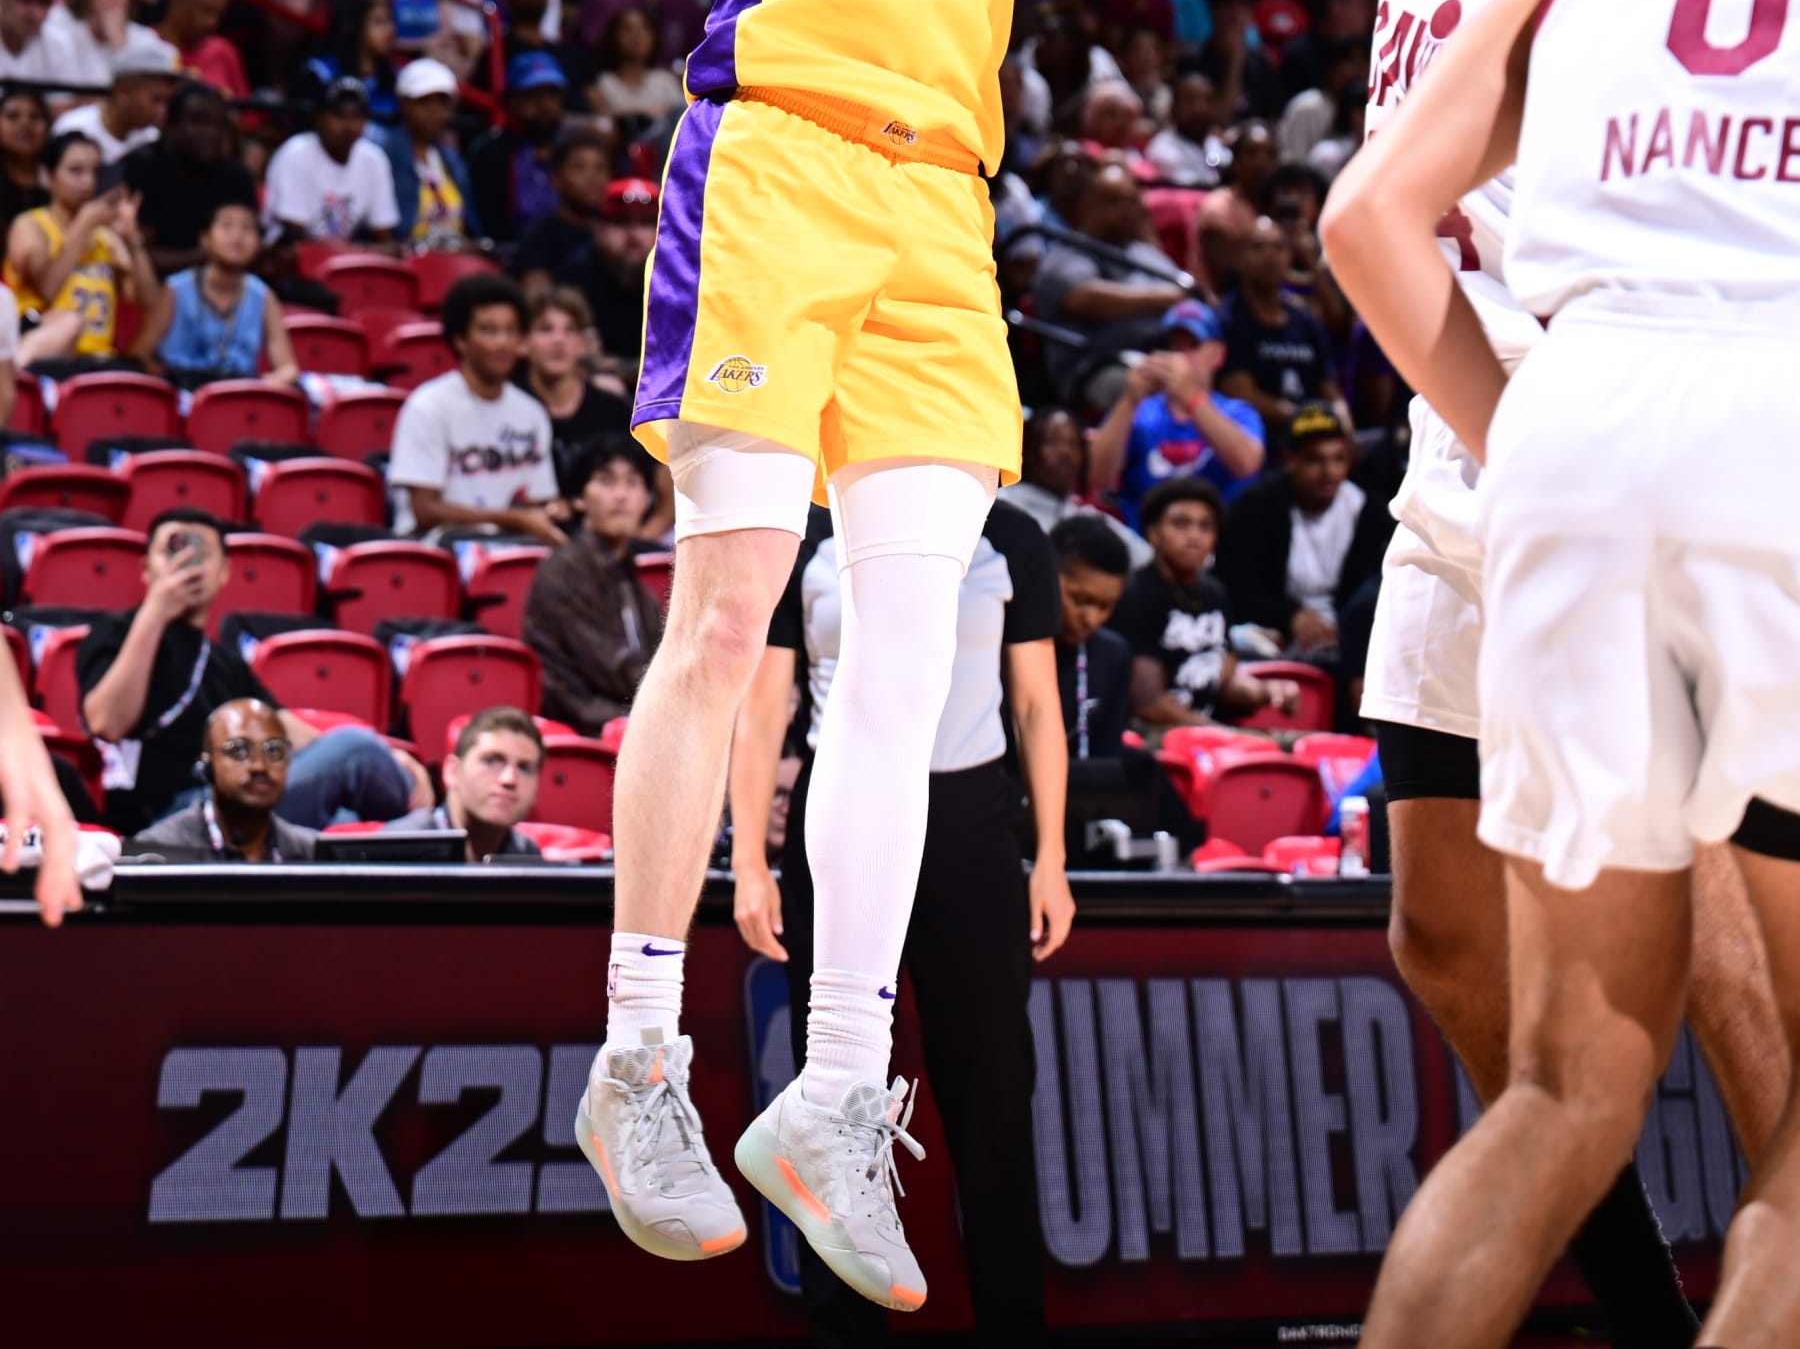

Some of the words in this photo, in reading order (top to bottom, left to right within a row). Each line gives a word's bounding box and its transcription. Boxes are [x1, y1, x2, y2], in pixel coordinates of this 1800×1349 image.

[1600, 106, 1800, 182] NANCE
[710, 363, 760, 387] LAKERS
[1029, 976, 1420, 1265] UMMER
